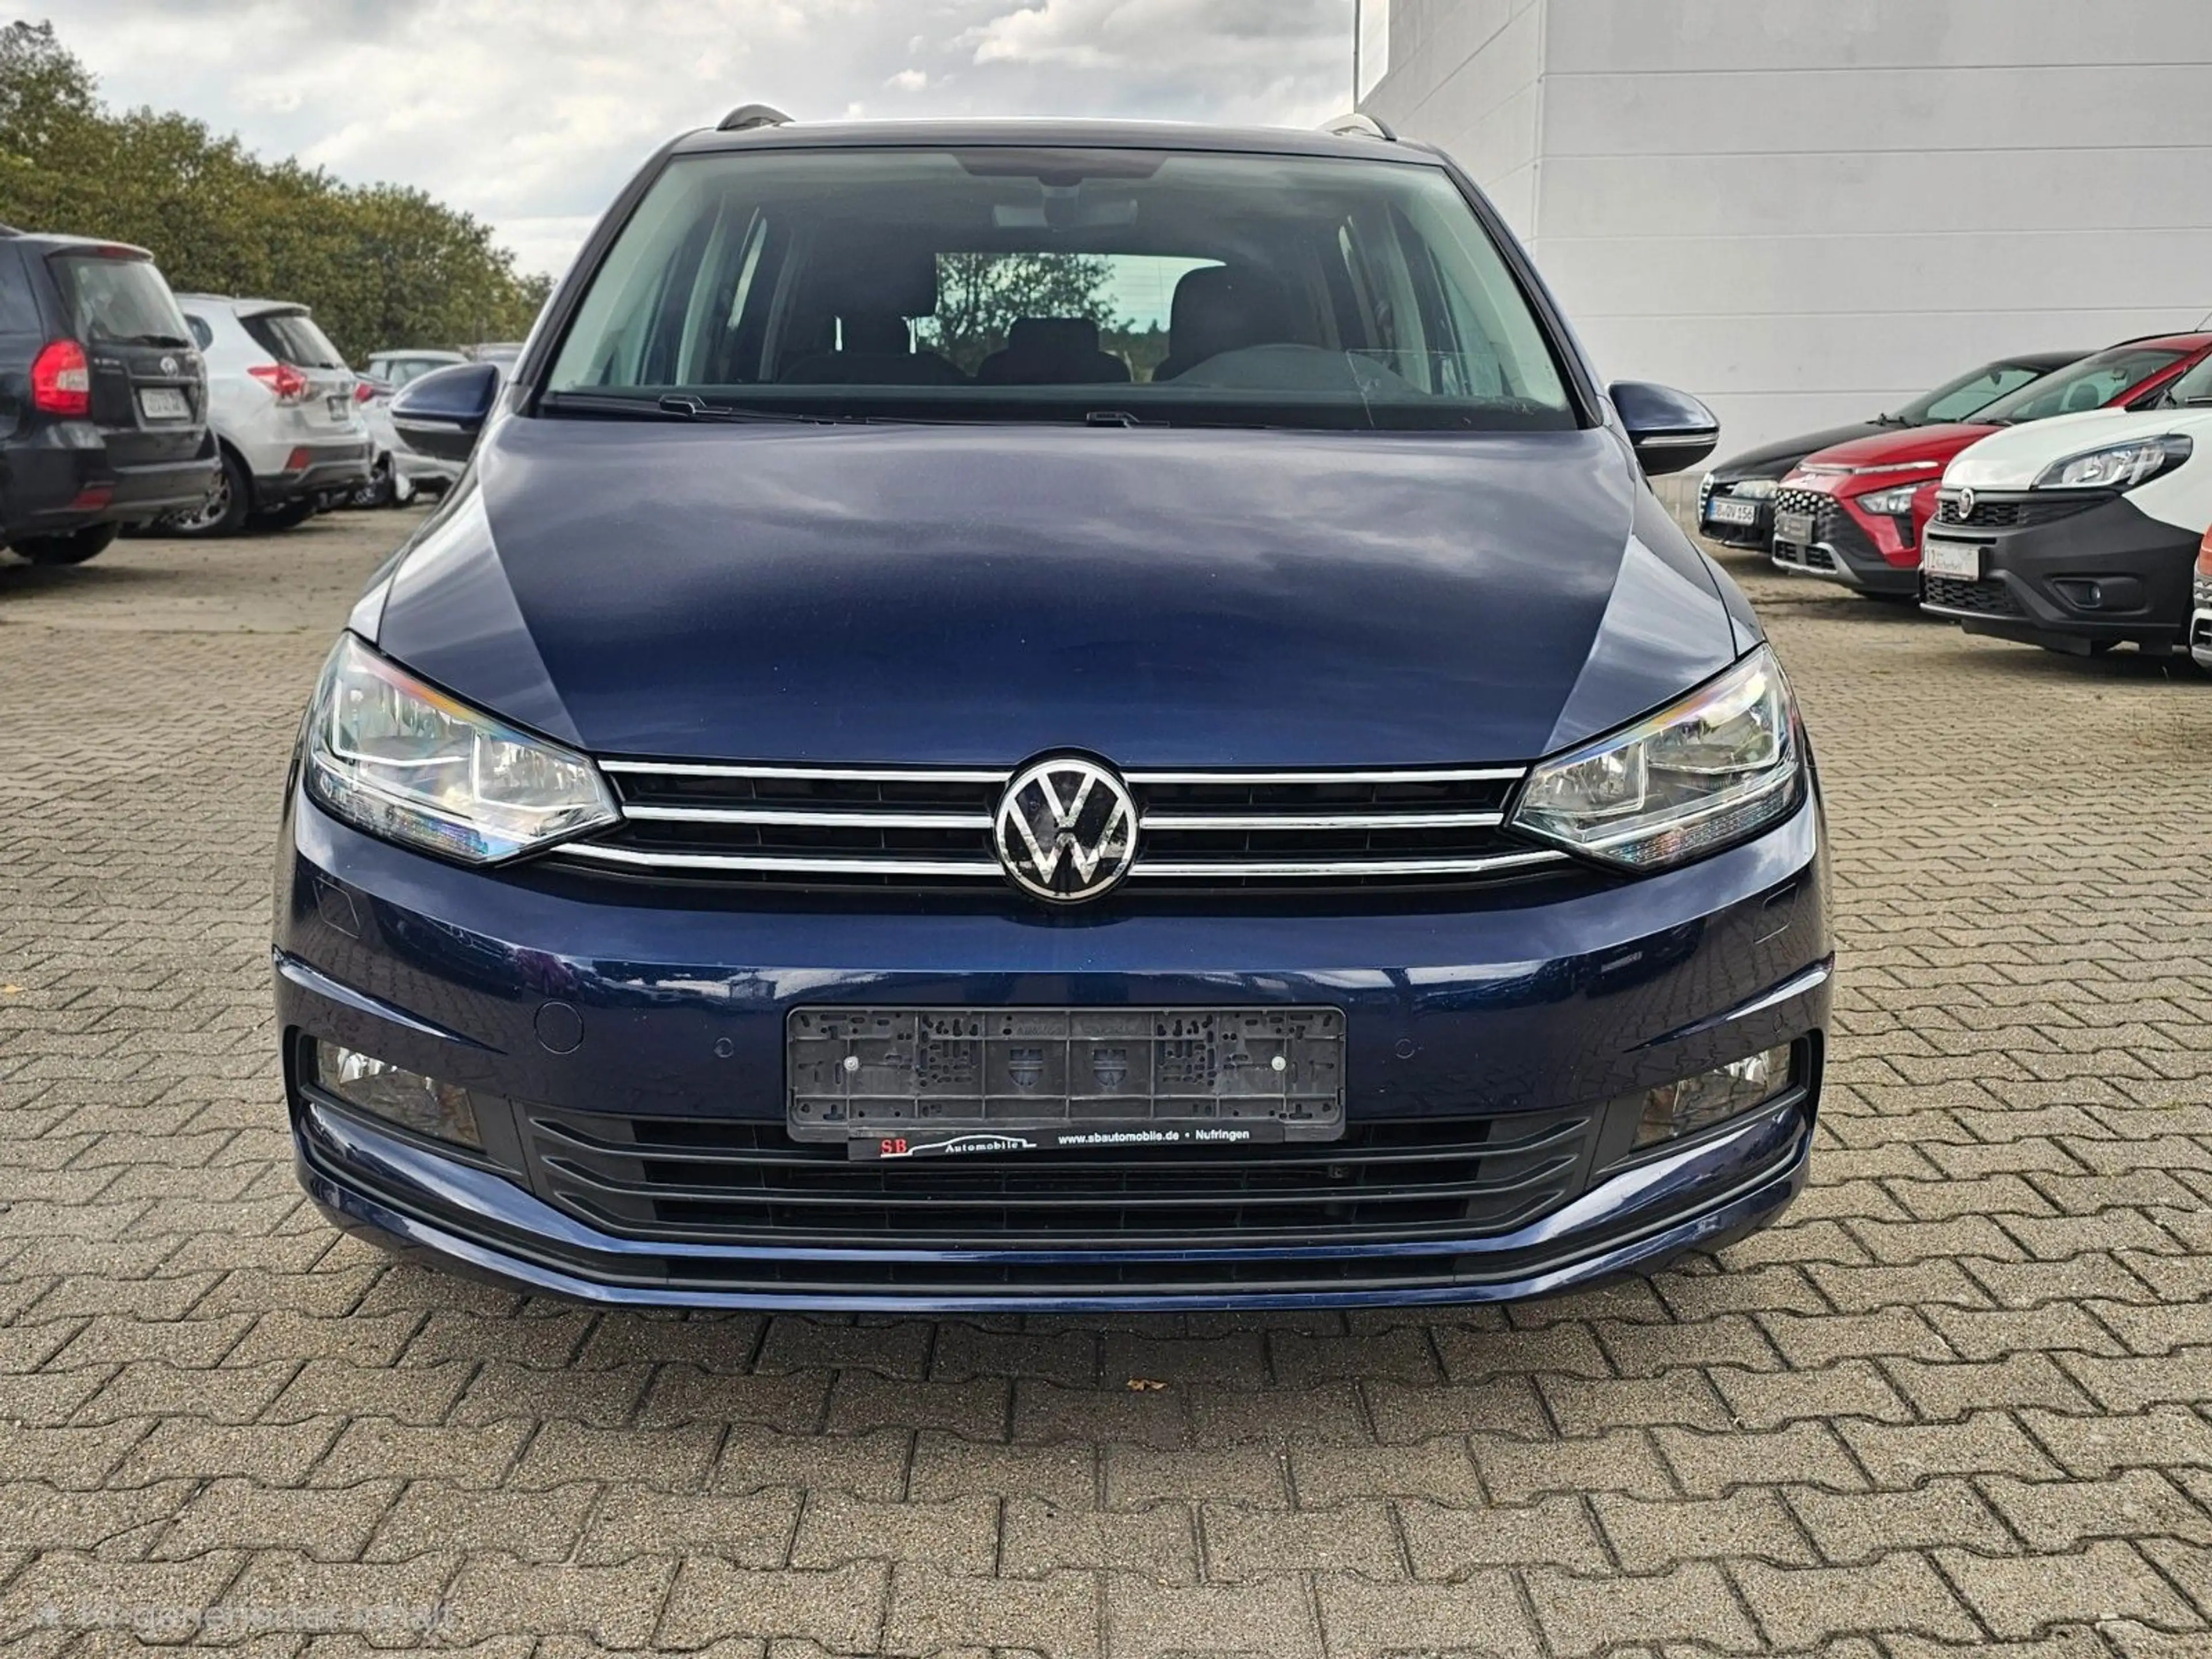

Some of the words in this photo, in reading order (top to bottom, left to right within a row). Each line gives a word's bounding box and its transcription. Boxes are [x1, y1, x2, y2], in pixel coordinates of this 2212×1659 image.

[1058, 1131, 1180, 1145] www.sbautomobile.de
[1195, 1129, 1249, 1142] Nufringen
[881, 1138, 908, 1153] SB
[945, 1141, 1018, 1153] Automobile
